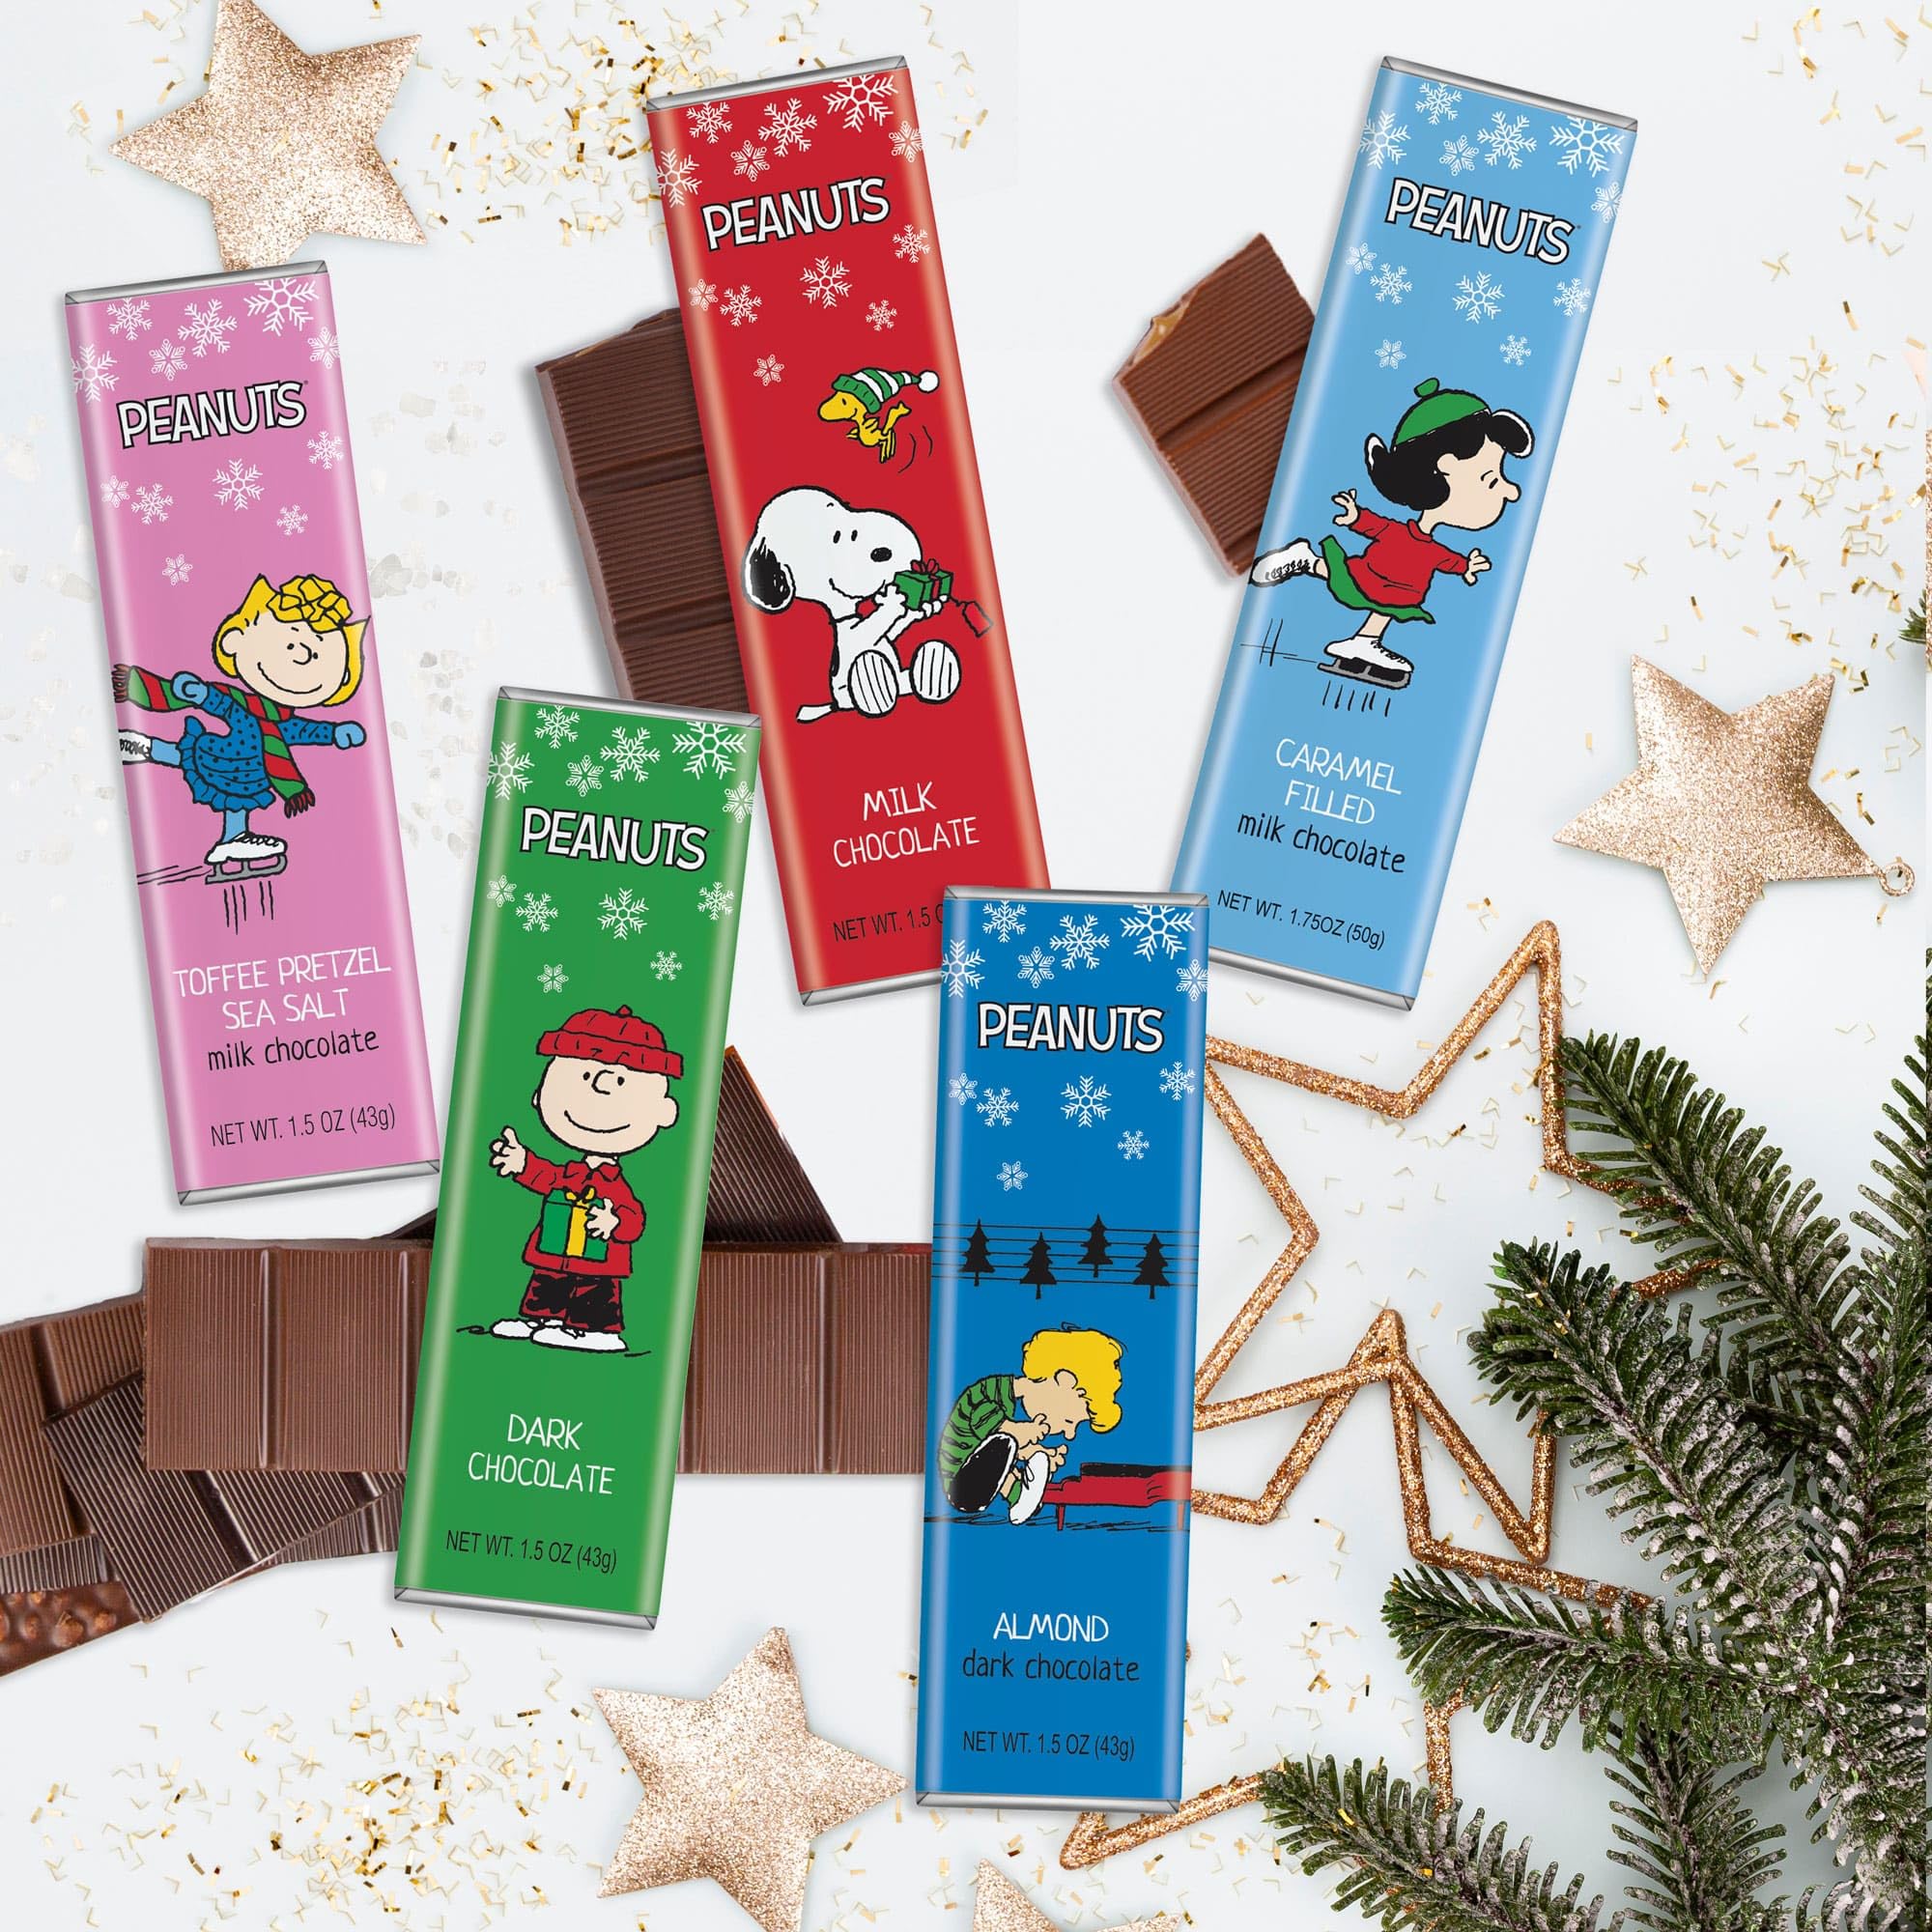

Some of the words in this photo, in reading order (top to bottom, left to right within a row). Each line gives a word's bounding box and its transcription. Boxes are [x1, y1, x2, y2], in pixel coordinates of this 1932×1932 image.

[700, 177, 891, 251] PEANUTS
[1384, 177, 1575, 266] PEANUTS
[116, 380, 307, 449] PEANUTS
[1276, 738, 1402, 795] CARAMEL
[863, 781, 937, 821] MILK
[1285, 780, 1376, 824] FILLED
[520, 806, 710, 872] PEANUTS
[833, 816, 980, 867] CHOCOLATE
[1237, 812, 1286, 843] milk
[1293, 825, 1406, 873] chocolate
[833, 917, 867, 943] NET
[871, 912, 903, 936] WT.
[906, 907, 932, 928] 1.5
[1217, 890, 1251, 912] NET
[1256, 898, 1283, 922] WT.
[1291, 909, 1345, 937] 1.75OZ
[1347, 922, 1385, 951] (50g)
[173, 960, 270, 997] TOFFEE
[277, 947, 391, 985] PRETZEL
[222, 999, 275, 1029] SEA
[283, 988, 349, 1022] SALT
[978, 1001, 1165, 1054] PEANUTS
[208, 1040, 255, 1071] milk
[265, 1028, 380, 1065] chocolate
[211, 1122, 244, 1147] NET
[250, 1117, 283, 1142] WT.
[288, 1114, 314, 1137] 1.5
[321, 1109, 344, 1133] OZ
[351, 1103, 395, 1134] (43g)
[507, 1413, 583, 1450] DARK
[468, 1452, 615, 1494] CHOCOLATE
[446, 1530, 481, 1554] NET
[486, 1534, 514, 1558] WT.
[521, 1538, 544, 1561] 1.5
[549, 1542, 572, 1565] OZ
[577, 1546, 617, 1575] (43g)
[993, 1612, 1109, 1642] ALMOND
[962, 1648, 1014, 1678] dark
[1025, 1652, 1140, 1681] chocolate
[963, 1731, 997, 1753] NET
[1003, 1732, 1032, 1753] WT.
[1038, 1733, 1060, 1754] 1.5
[1066, 1734, 1090, 1754] OZ
[1094, 1735, 1134, 1762] (43g)
